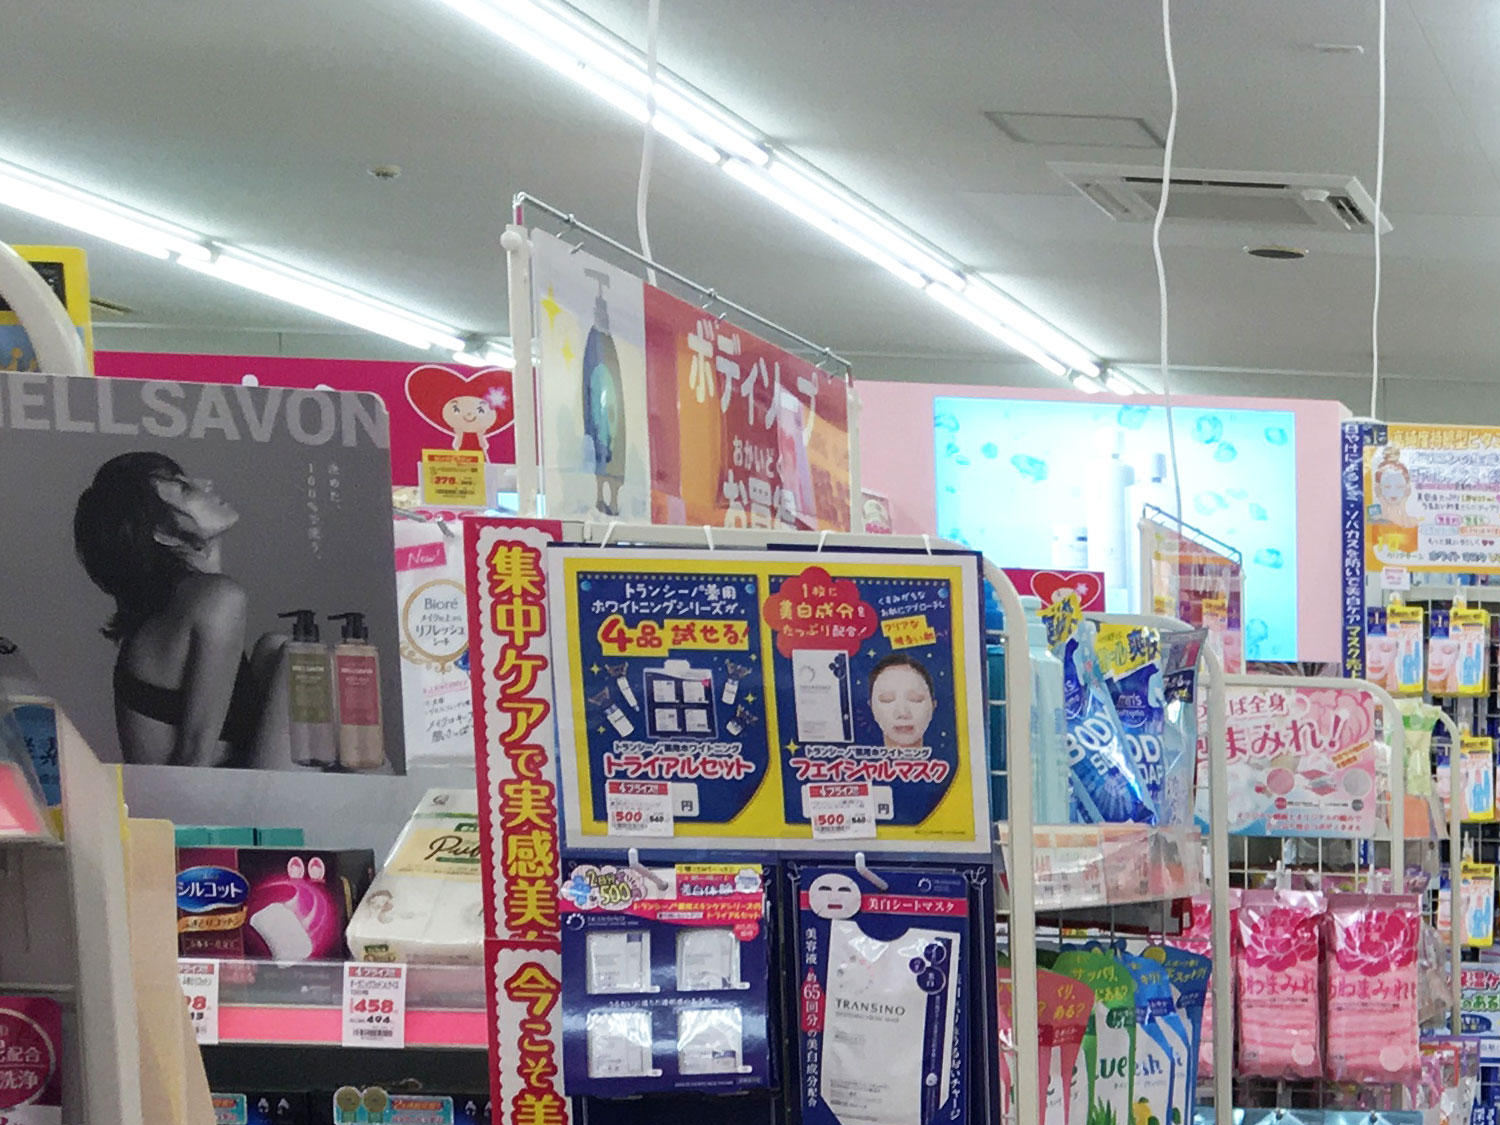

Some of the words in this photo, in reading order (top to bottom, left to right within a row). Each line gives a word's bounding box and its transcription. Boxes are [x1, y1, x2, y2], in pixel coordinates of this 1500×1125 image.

[0, 373, 390, 450] ELLSAVON
[424, 597, 459, 610] Bioré
[415, 623, 466, 637] リフレッシュ
[599, 616, 749, 652] 4品試せる!
[492, 545, 556, 938] 集中ケアで実感美
[604, 755, 755, 780] トライアルセット
[790, 758, 949, 783] フェイシャルマスク
[682, 800, 694, 813] 円
[878, 803, 891, 815] 円
[615, 811, 643, 823] 500
[817, 813, 845, 826] 500
[177, 879, 244, 899] シルコット
[868, 896, 956, 913] 美白シートマスク
[353, 999, 393, 1014] 458
[836, 998, 906, 1017] TRANSINO
